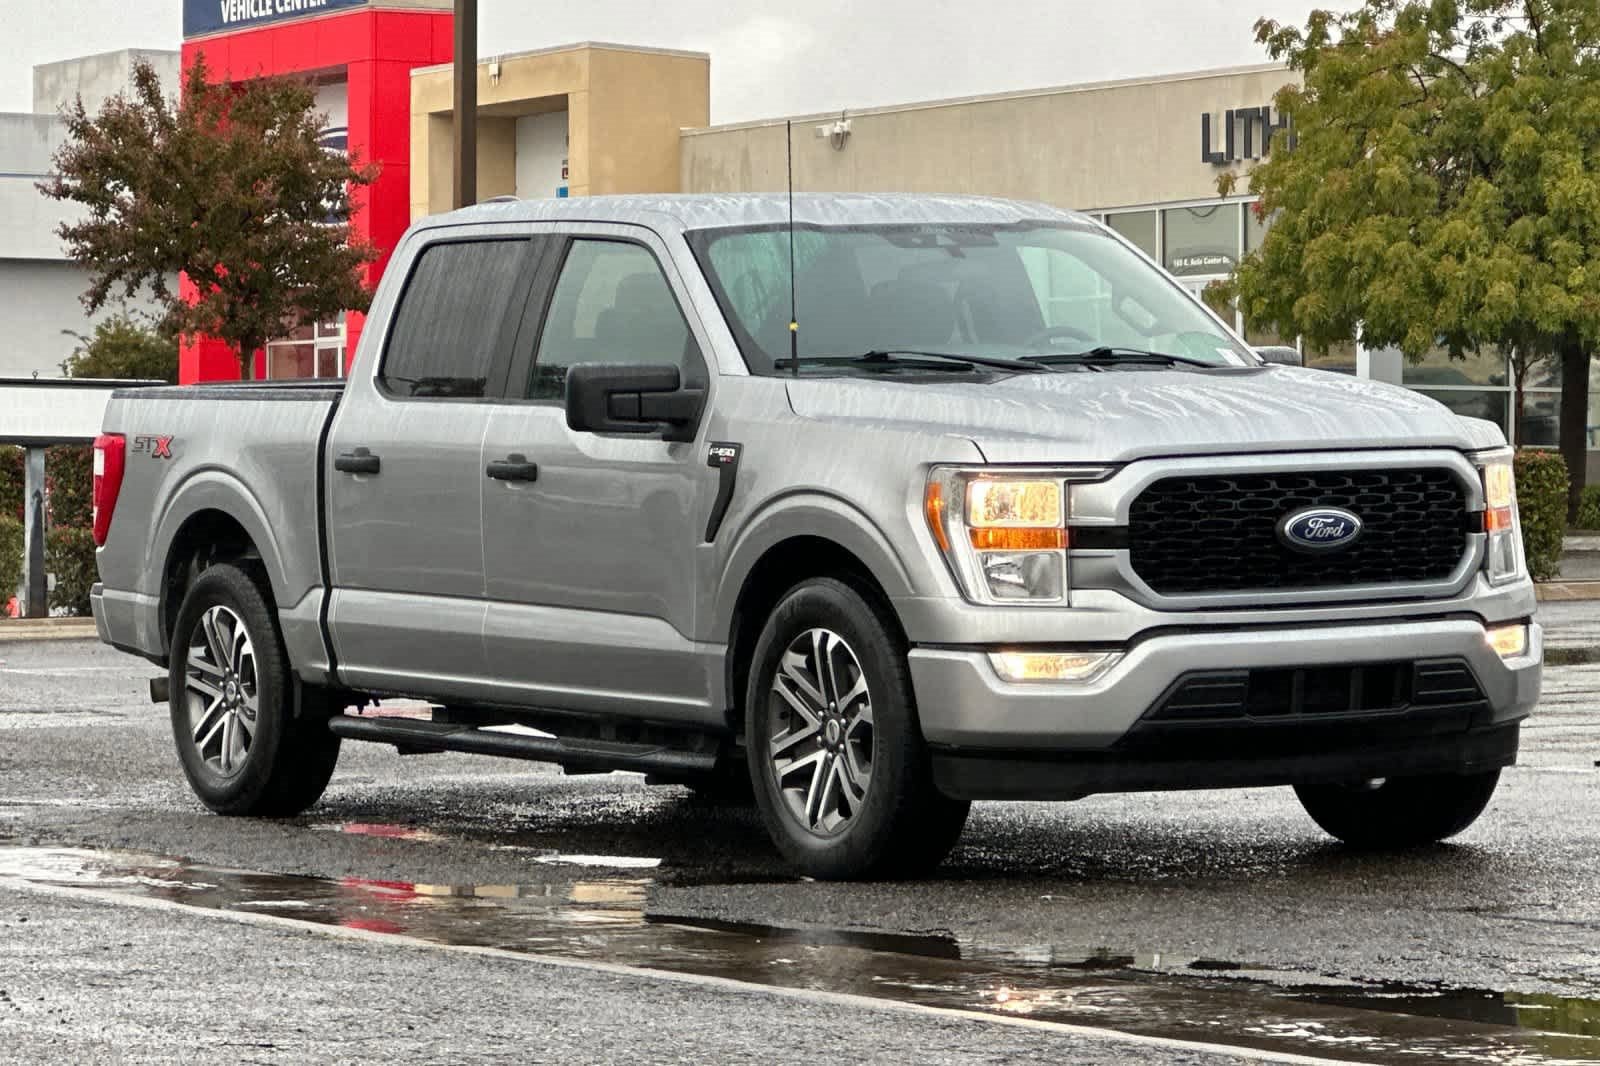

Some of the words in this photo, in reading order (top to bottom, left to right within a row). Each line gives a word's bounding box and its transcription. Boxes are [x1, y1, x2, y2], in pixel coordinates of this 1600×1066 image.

[220, 0, 273, 24] VEHICLE
[132, 435, 174, 459] STX
[1304, 517, 1345, 539] Ford
